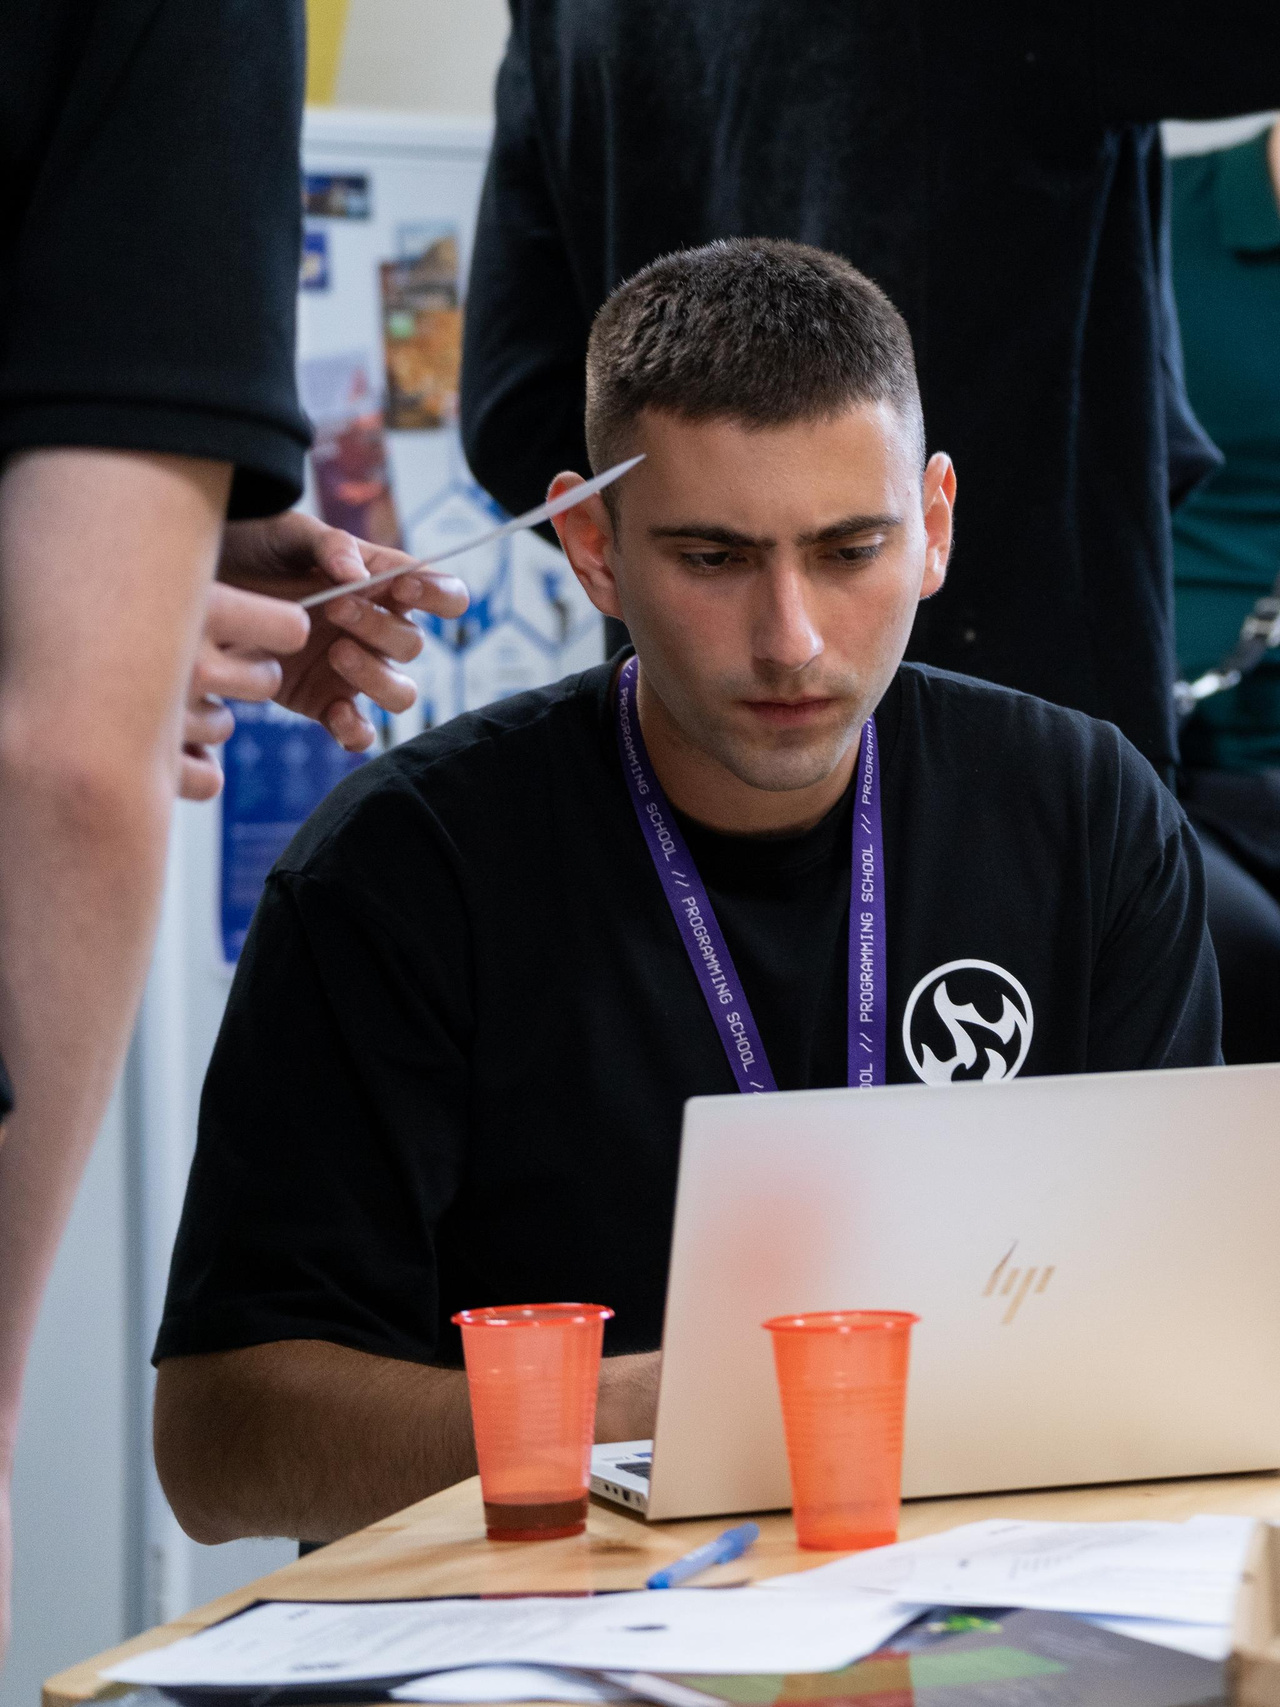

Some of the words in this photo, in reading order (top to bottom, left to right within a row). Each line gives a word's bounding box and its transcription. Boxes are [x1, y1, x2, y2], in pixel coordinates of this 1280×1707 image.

[860, 813, 873, 835] //
[620, 687, 649, 795] PROGRAMMING
[646, 802, 673, 862] SCHOOL
[671, 871, 690, 888] //
[681, 896, 734, 1006] PROGRAMMING
[726, 1011, 756, 1073] SCHOOL
[861, 843, 875, 904] SCHOOL
[860, 912, 874, 1023] PROGRAMMING
[859, 1032, 873, 1053] //
[982, 1240, 1056, 1326] hp
